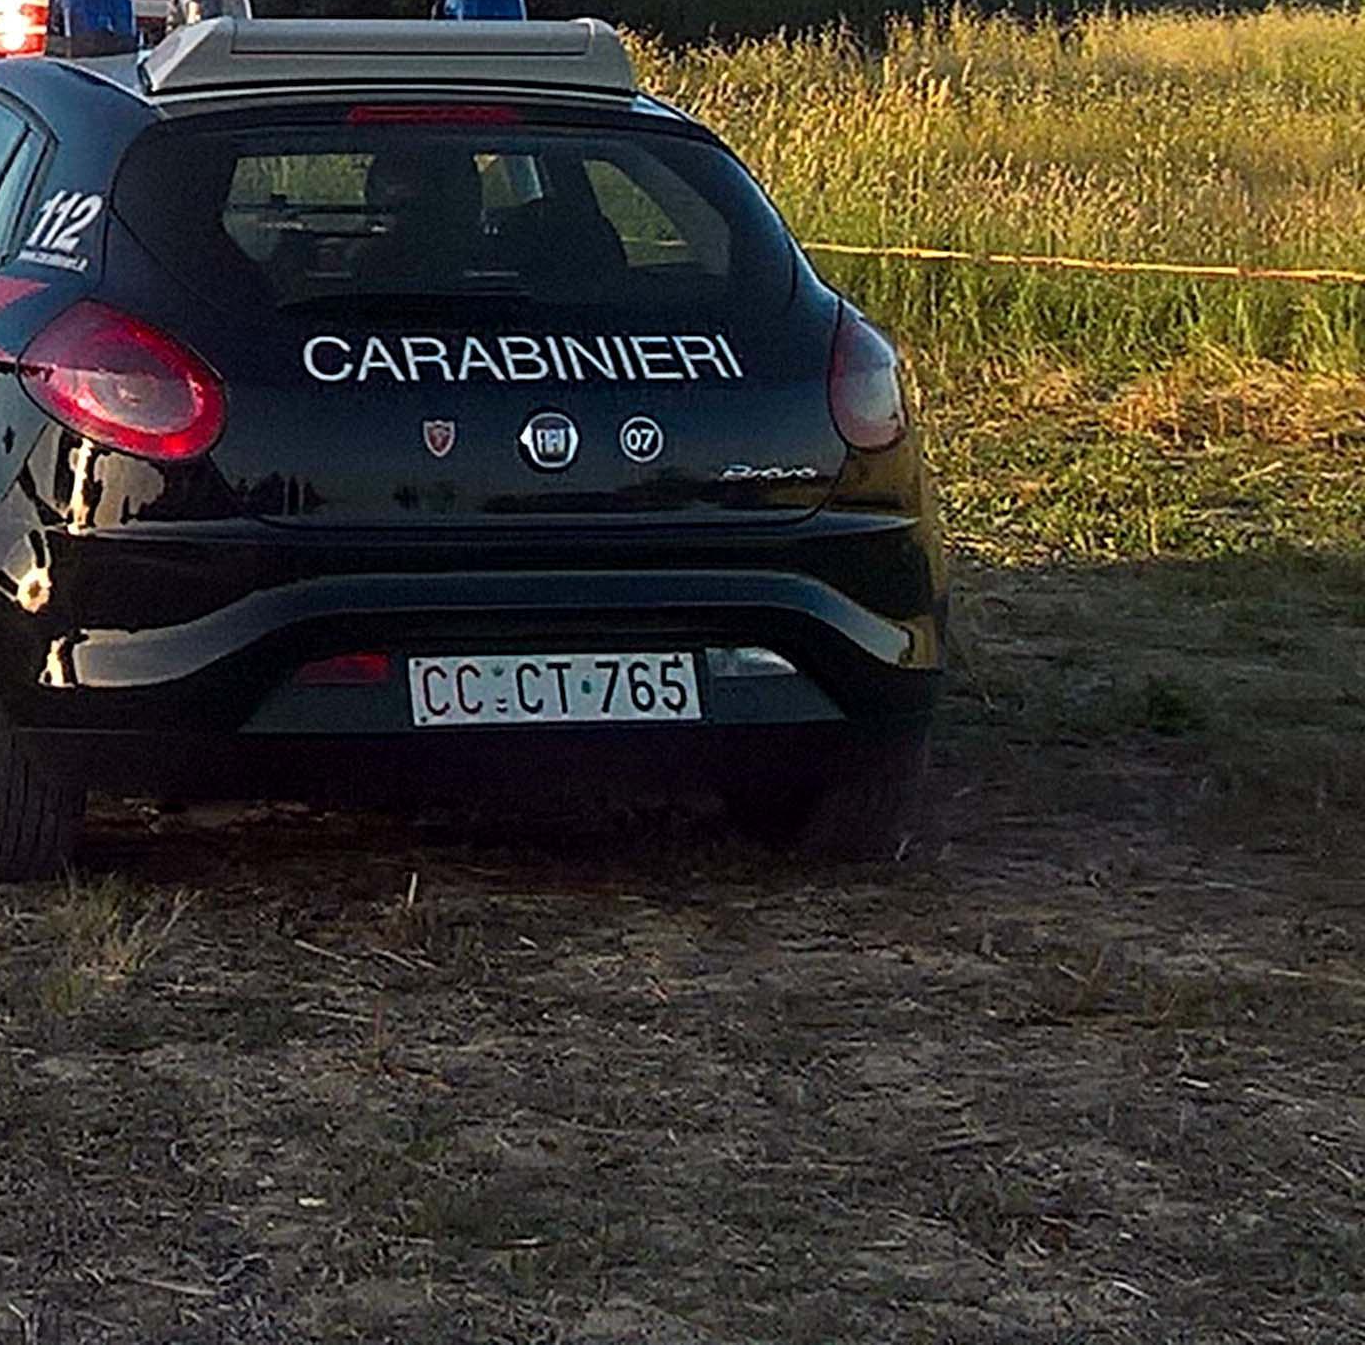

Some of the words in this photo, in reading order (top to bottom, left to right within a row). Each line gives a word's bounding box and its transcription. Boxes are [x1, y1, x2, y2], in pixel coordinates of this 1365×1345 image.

[26, 189, 103, 252] 112
[303, 334, 744, 382] CARABINIERI
[624, 428, 656, 452] 07
[423, 665, 484, 716] CC
[516, 661, 572, 715] CT
[595, 659, 687, 714] 765
